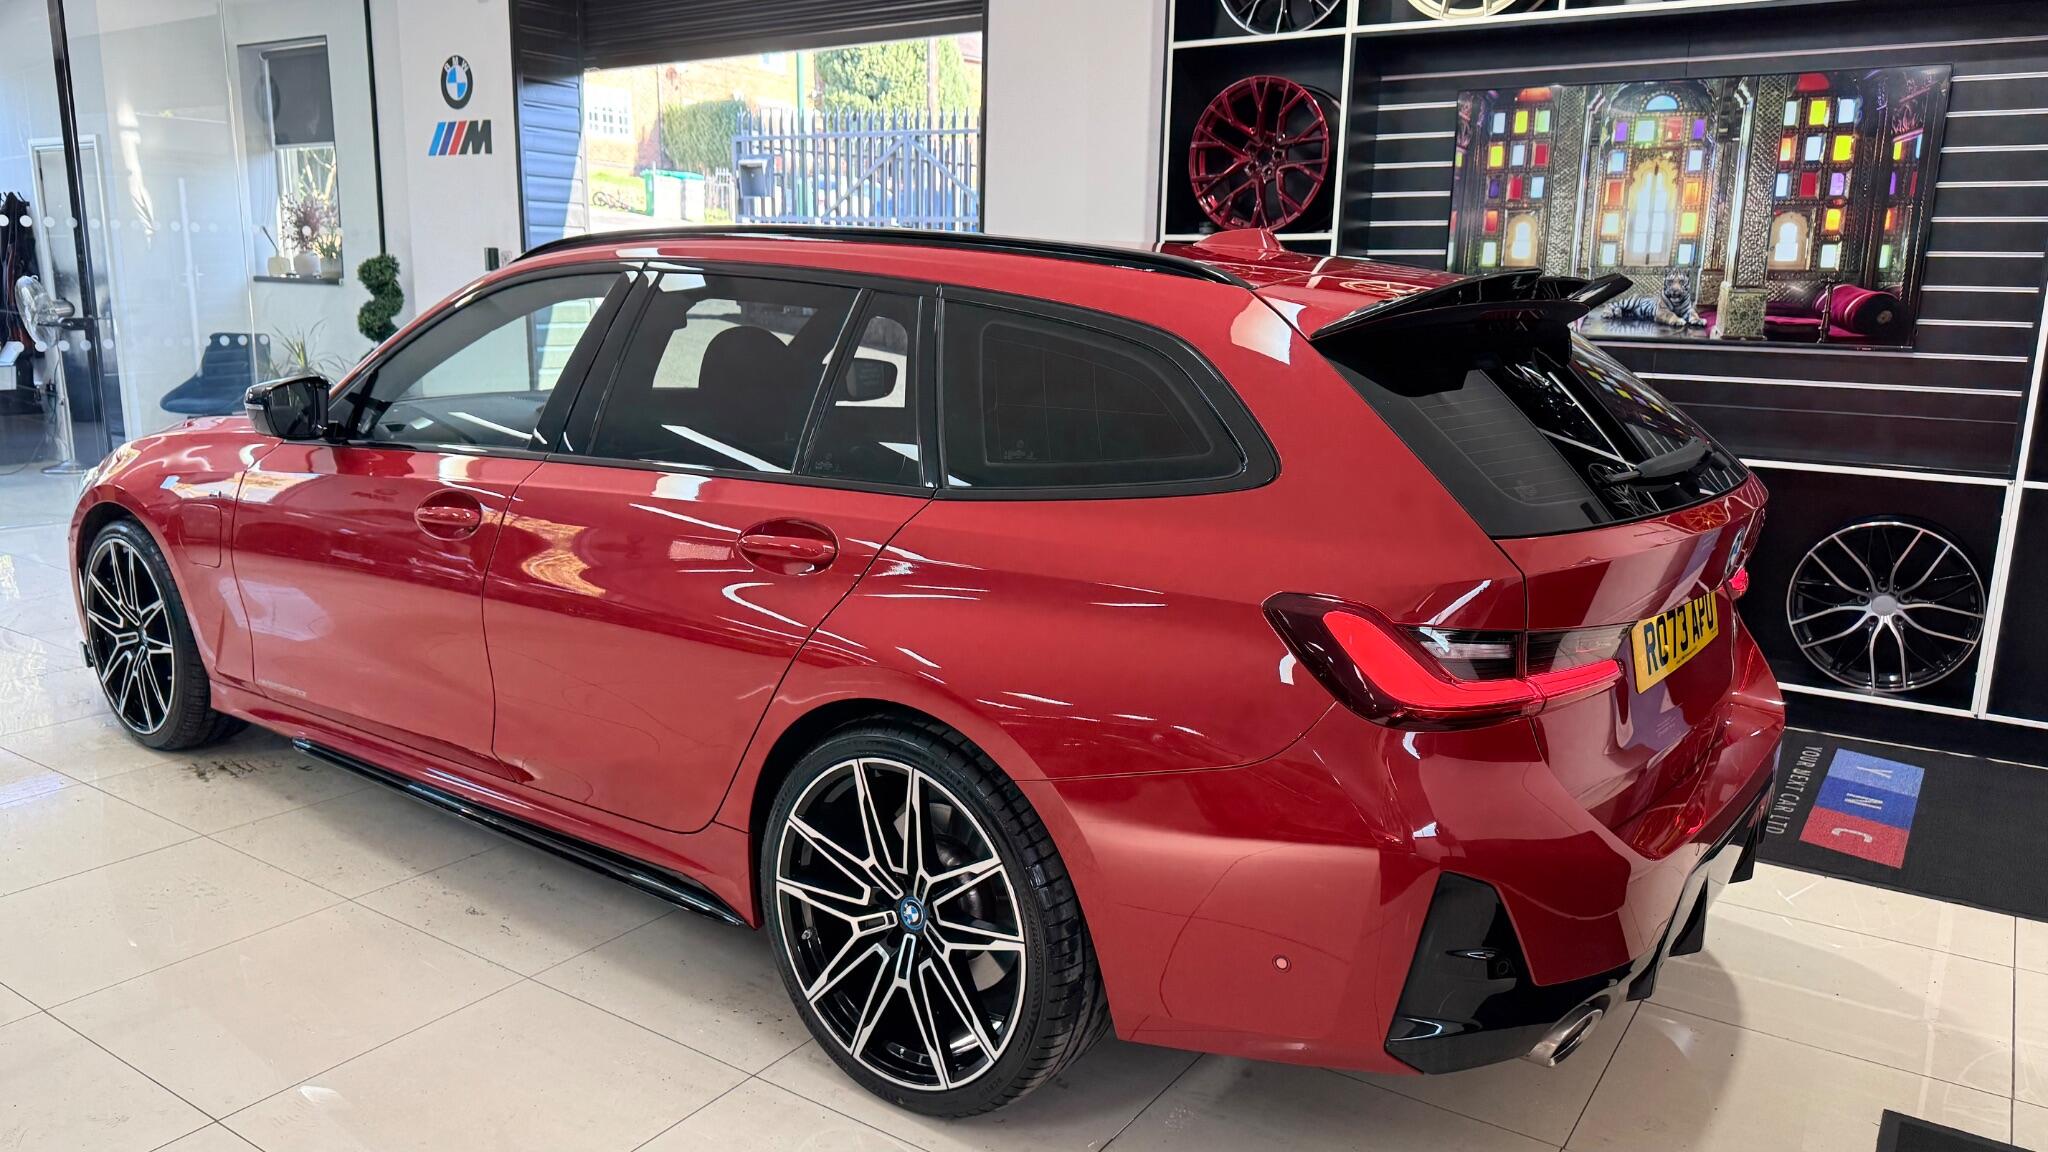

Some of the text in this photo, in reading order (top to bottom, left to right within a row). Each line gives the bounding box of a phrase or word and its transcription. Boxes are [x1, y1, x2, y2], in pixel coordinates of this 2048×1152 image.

[1691, 592, 1714, 644] APU
[1765, 746, 1824, 834] YOUR NEXT CAR LTD
